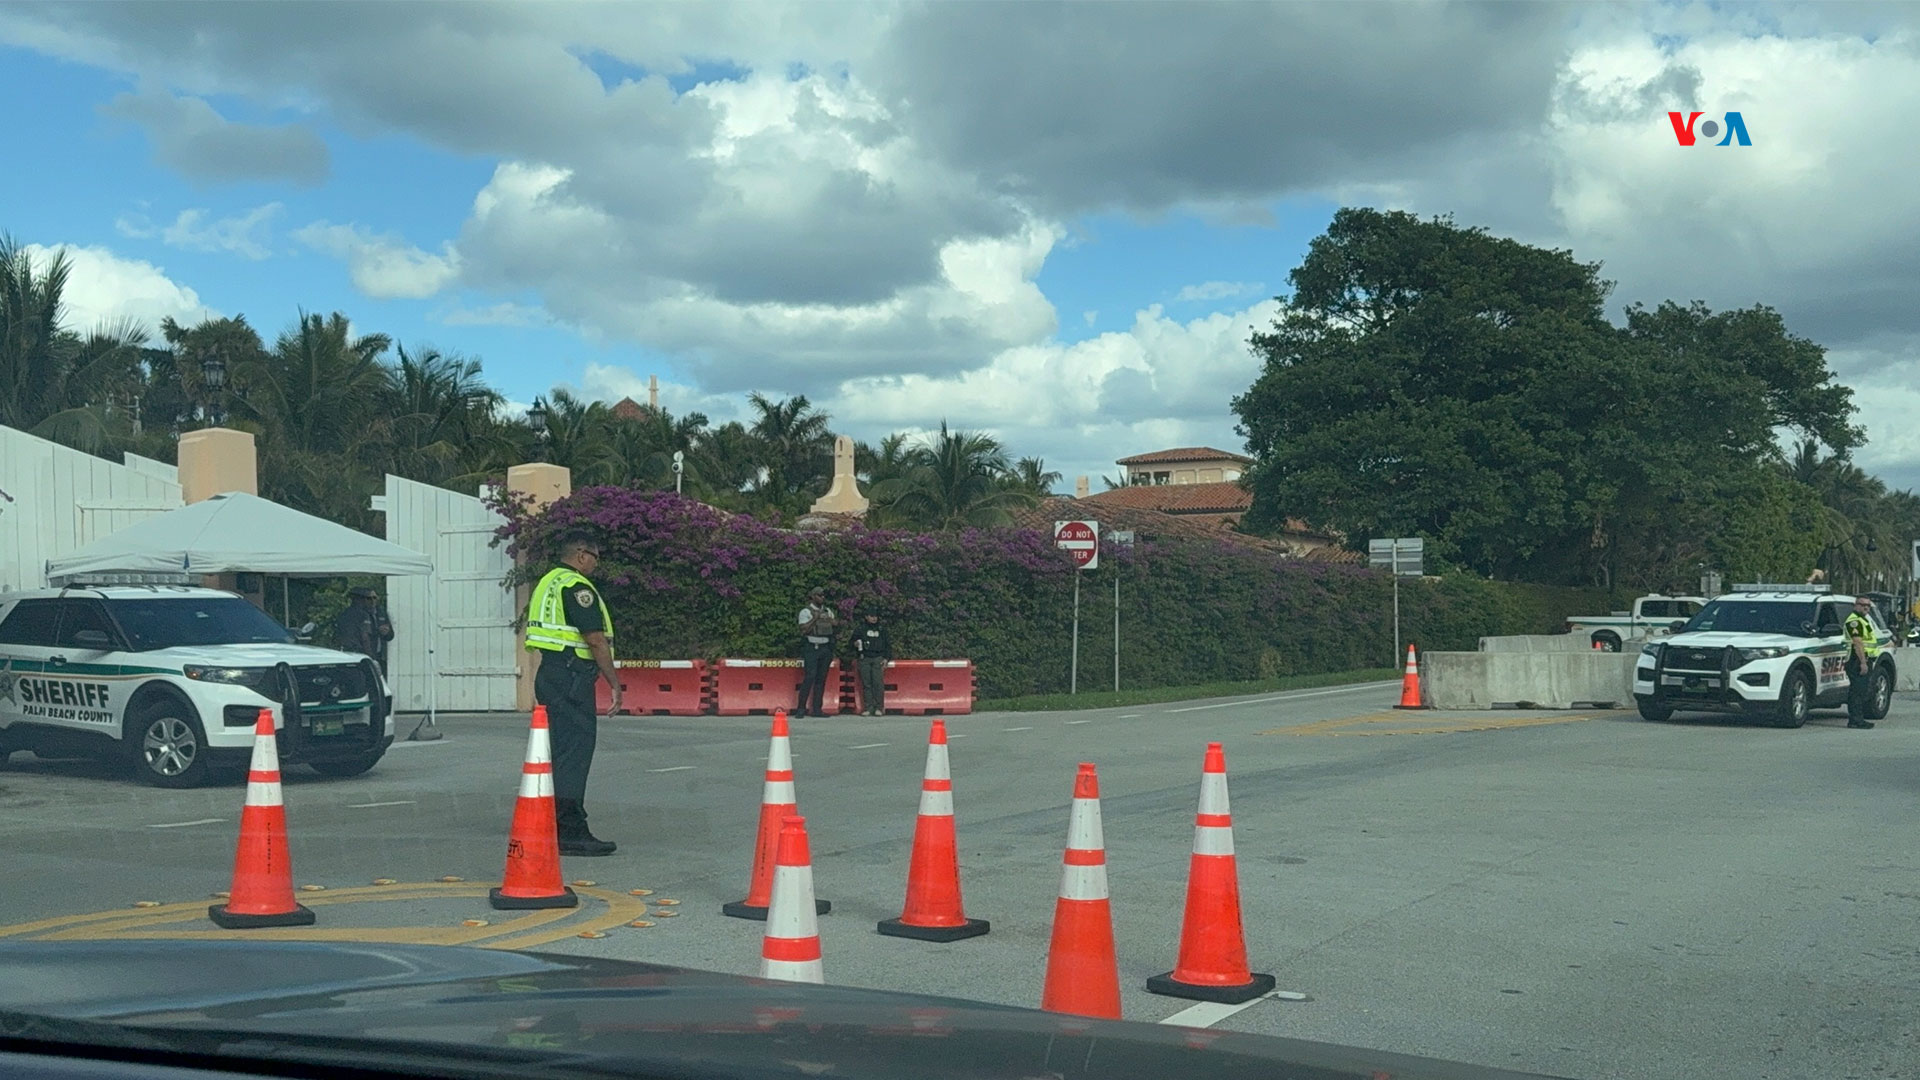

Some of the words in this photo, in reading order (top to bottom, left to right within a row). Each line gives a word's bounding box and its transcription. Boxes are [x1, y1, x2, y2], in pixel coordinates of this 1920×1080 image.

[1061, 530, 1072, 539] DO
[1076, 530, 1091, 539] NOT
[1073, 551, 1088, 559] TER
[19, 678, 109, 708] SHERIFF
[23, 705, 46, 717] PALM
[48, 708, 76, 720] BEACH
[78, 710, 113, 723] COUNTY
